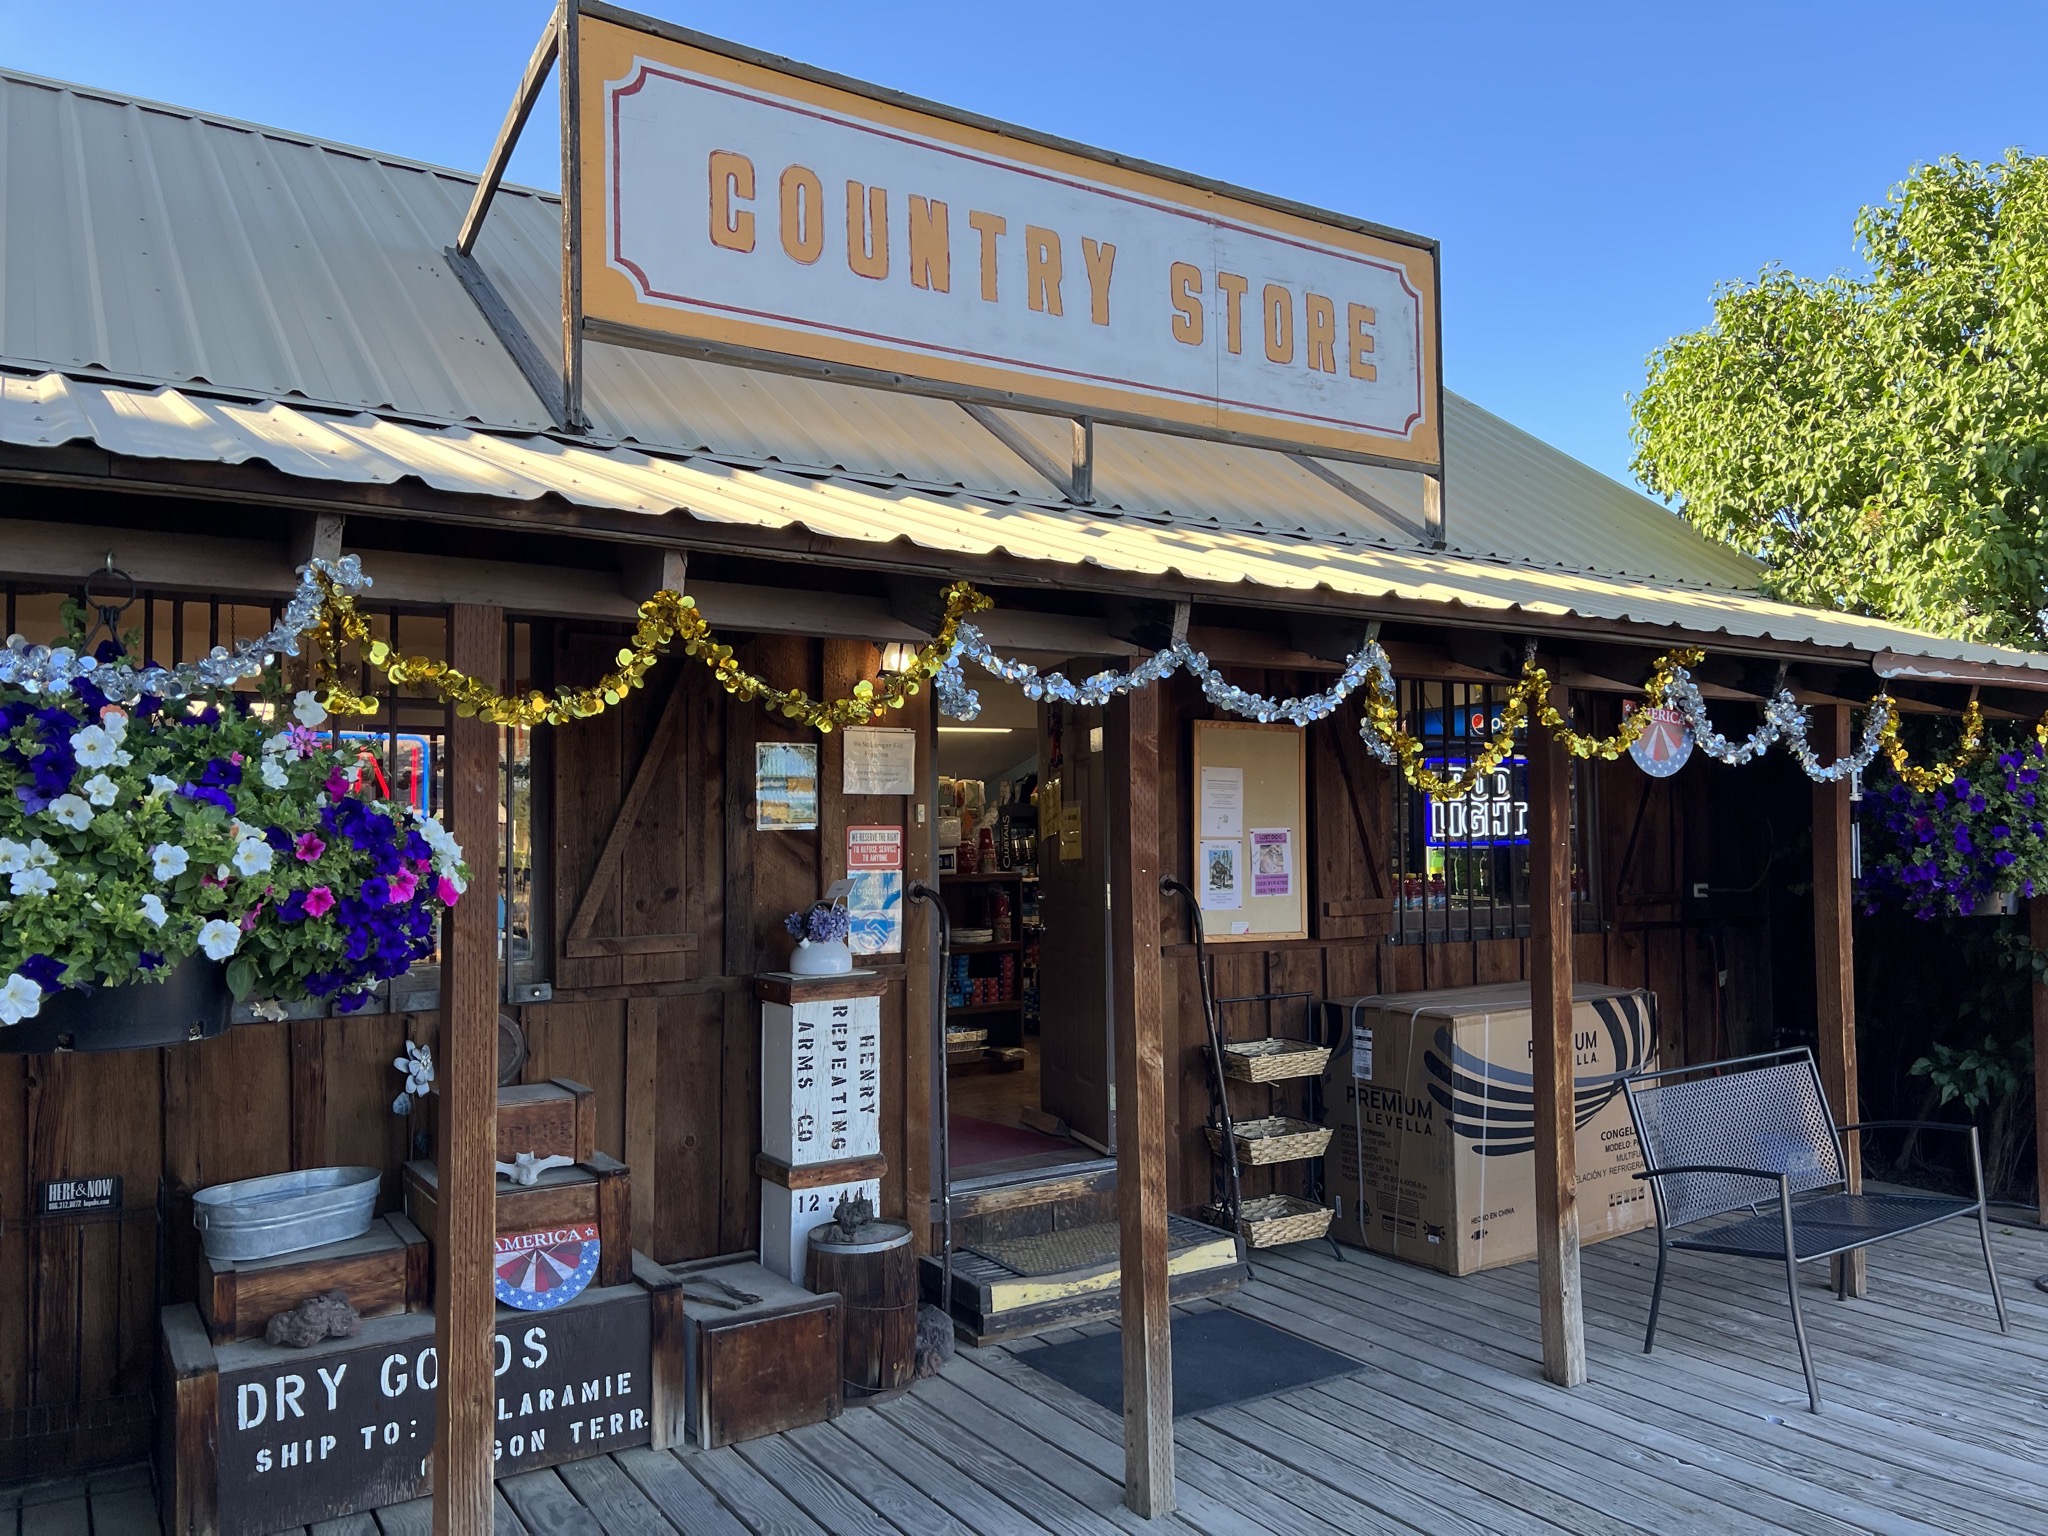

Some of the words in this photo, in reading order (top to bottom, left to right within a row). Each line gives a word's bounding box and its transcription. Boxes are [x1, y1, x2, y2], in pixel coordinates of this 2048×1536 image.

[708, 148, 1116, 327] COUNTRY
[1170, 260, 1379, 383] STORE
[870, 742, 892, 750] Longer
[1431, 801, 1529, 837] LIGHT
[852, 832, 858, 842] WE
[860, 832, 878, 842] RESERVE
[878, 832, 886, 842] THE
[886, 832, 899, 842] RIGHT
[1002, 815, 1011, 868] CLUBTAILS
[853, 846, 860, 854] TO
[860, 846, 878, 854] REFUSE
[878, 845, 897, 854] SERVICE
[862, 854, 869, 862] TO
[870, 854, 888, 862] ANYONE
[850, 887, 898, 896] Handshake
[868, 876, 880, 884] NO
[864, 896, 884, 906] Zone
[797, 1021, 814, 1090] ARMS
[831, 1005, 848, 1150] REPEATING
[859, 1034, 875, 1114] HENRY
[1346, 1085, 1433, 1120] PREMIUM
[1604, 1140, 1632, 1153] MODELO:
[1616, 1151, 1642, 1162] MULTIFU
[1576, 1170, 1602, 1184] ELACIÓN
[1602, 1168, 1607, 1177] Y
[1608, 1160, 1644, 1176] REFRIGERA
[1490, 1212, 1498, 1220] EN
[1498, 1207, 1515, 1218] CHINA
[495, 1229, 582, 1253] AMERICA
[237, 1363, 347, 1431] DRY
[380, 1326, 548, 1397] GODS
[255, 1435, 337, 1473] SHIP
[360, 1419, 417, 1450] TO:
[497, 1371, 632, 1421] LARAMIE
[569, 1408, 649, 1444] TERR.
